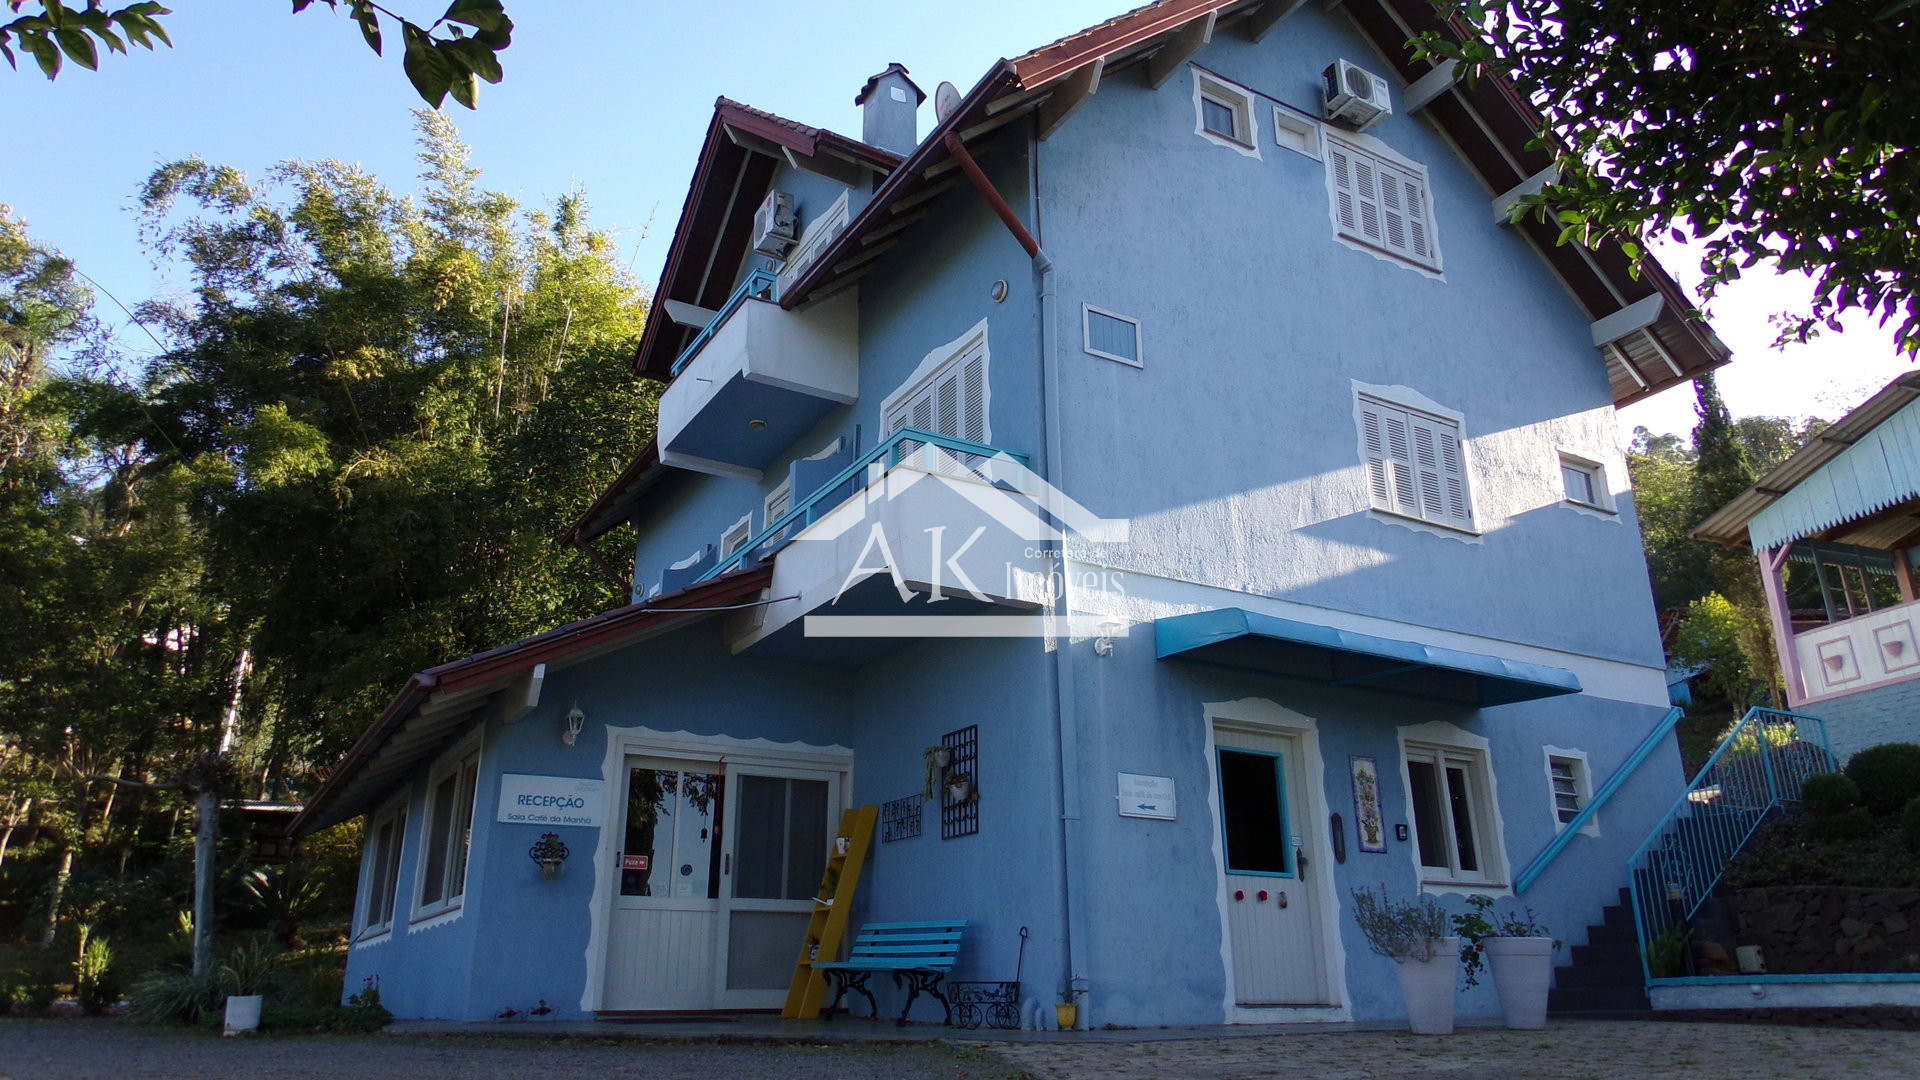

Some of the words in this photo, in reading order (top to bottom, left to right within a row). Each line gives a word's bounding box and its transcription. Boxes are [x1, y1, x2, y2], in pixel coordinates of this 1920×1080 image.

[517, 794, 584, 810] RECEPÇÃO
[507, 813, 525, 821] Sala
[527, 814, 547, 822] Café
[550, 814, 562, 822] da
[563, 815, 591, 824] Manhã
